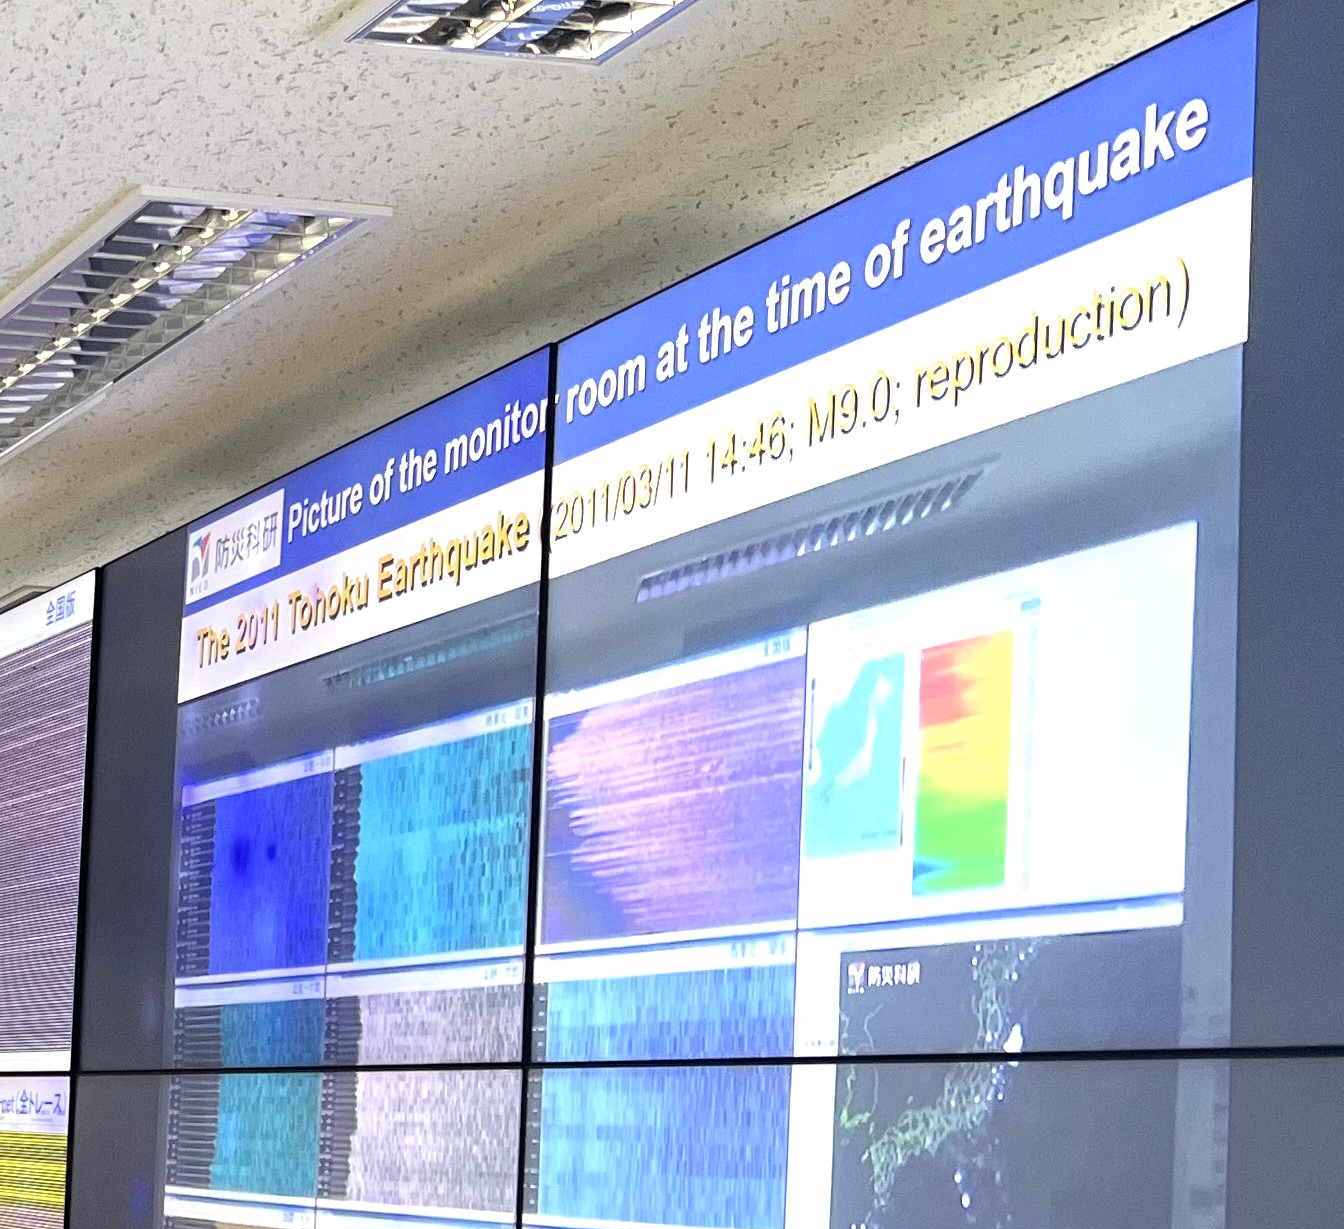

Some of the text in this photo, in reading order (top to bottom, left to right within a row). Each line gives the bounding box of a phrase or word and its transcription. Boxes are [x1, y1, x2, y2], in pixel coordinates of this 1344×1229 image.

[288, 98, 1210, 544] Picture of the monitor room at the time of earthquake
[197, 625, 231, 669] The
[235, 598, 280, 656] 2011
[288, 572, 370, 635] Tohoku
[377, 511, 531, 604] Earthquake
[706, 410, 795, 484] 14:46;
[808, 369, 901, 447] M9.0;
[915, 255, 1191, 408] reproduction)
[214, 511, 279, 574] 防災科研
[46, 590, 76, 626] 全国版
